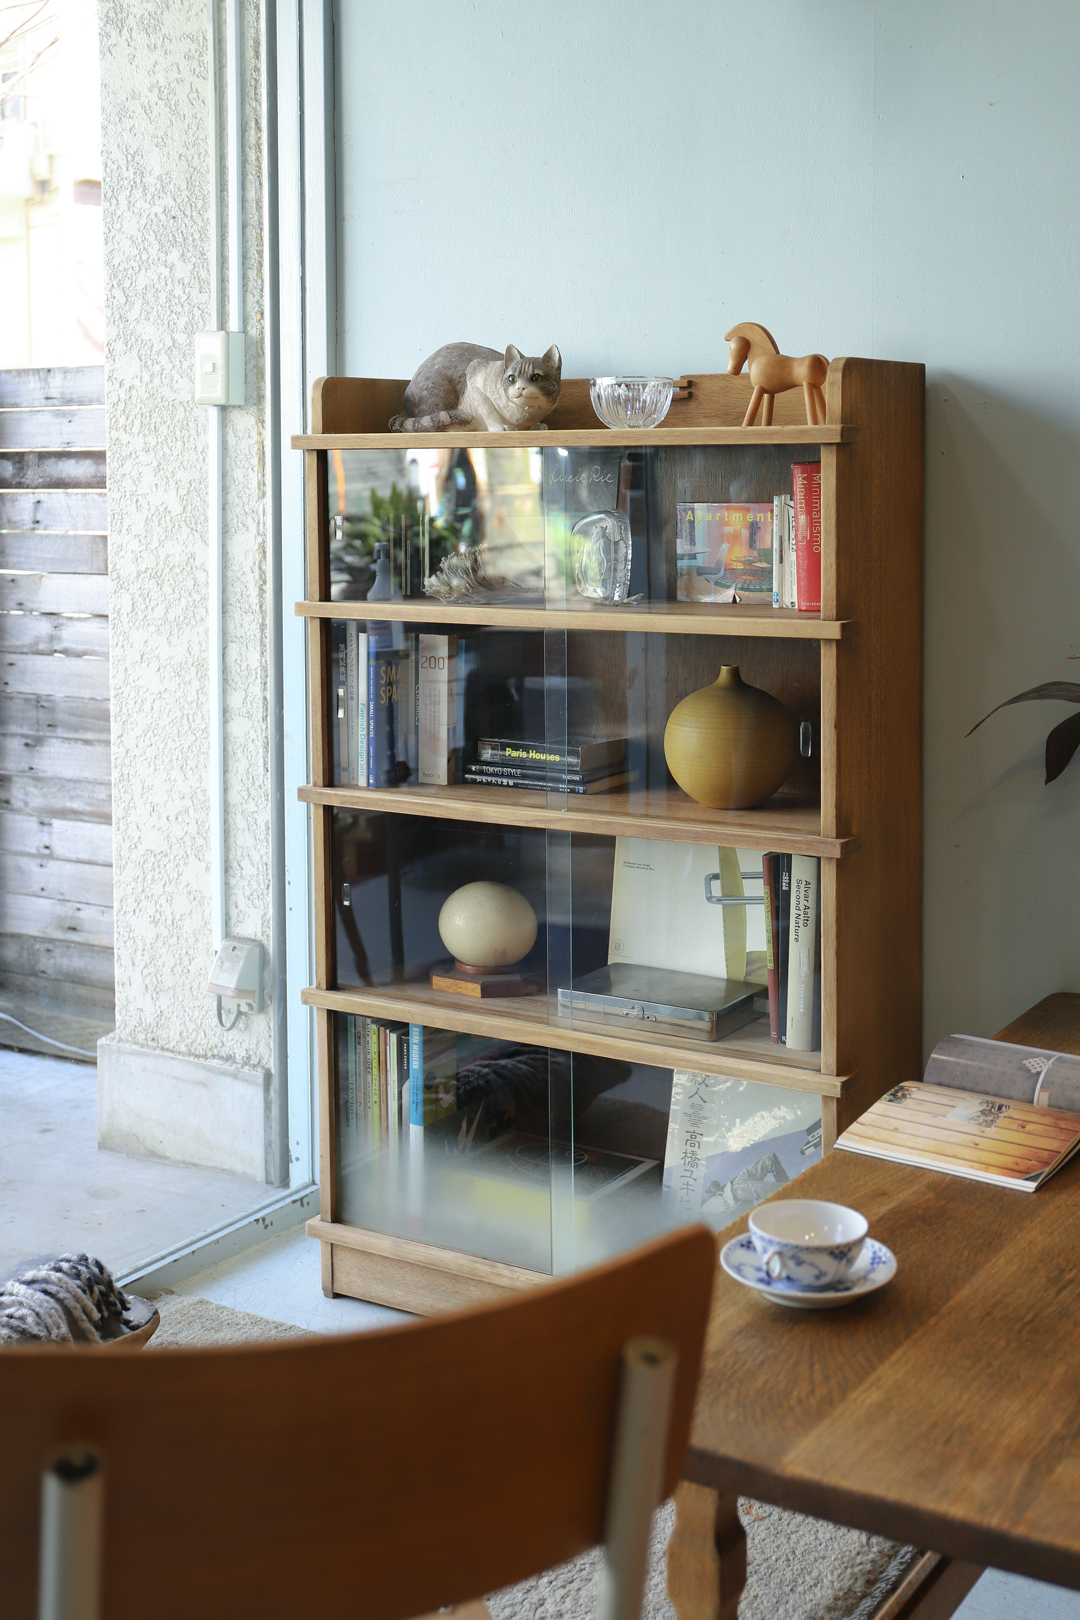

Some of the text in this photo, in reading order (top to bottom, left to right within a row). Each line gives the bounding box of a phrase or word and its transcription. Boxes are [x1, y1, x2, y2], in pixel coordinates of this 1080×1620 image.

[549, 463, 614, 486] Lucie Rie
[686, 510, 773, 522] Apartment
[811, 473, 821, 553] Minimalismo
[421, 656, 445, 670] 200
[380, 683, 407, 705] SPACE
[505, 747, 560, 762] Paris Houses
[483, 765, 521, 777] TOKYO STYLE
[793, 878, 803, 943] Second Nature
[802, 879, 811, 928] Alvar Aalto
[680, 1129, 704, 1213] 高橋ユキヒ
